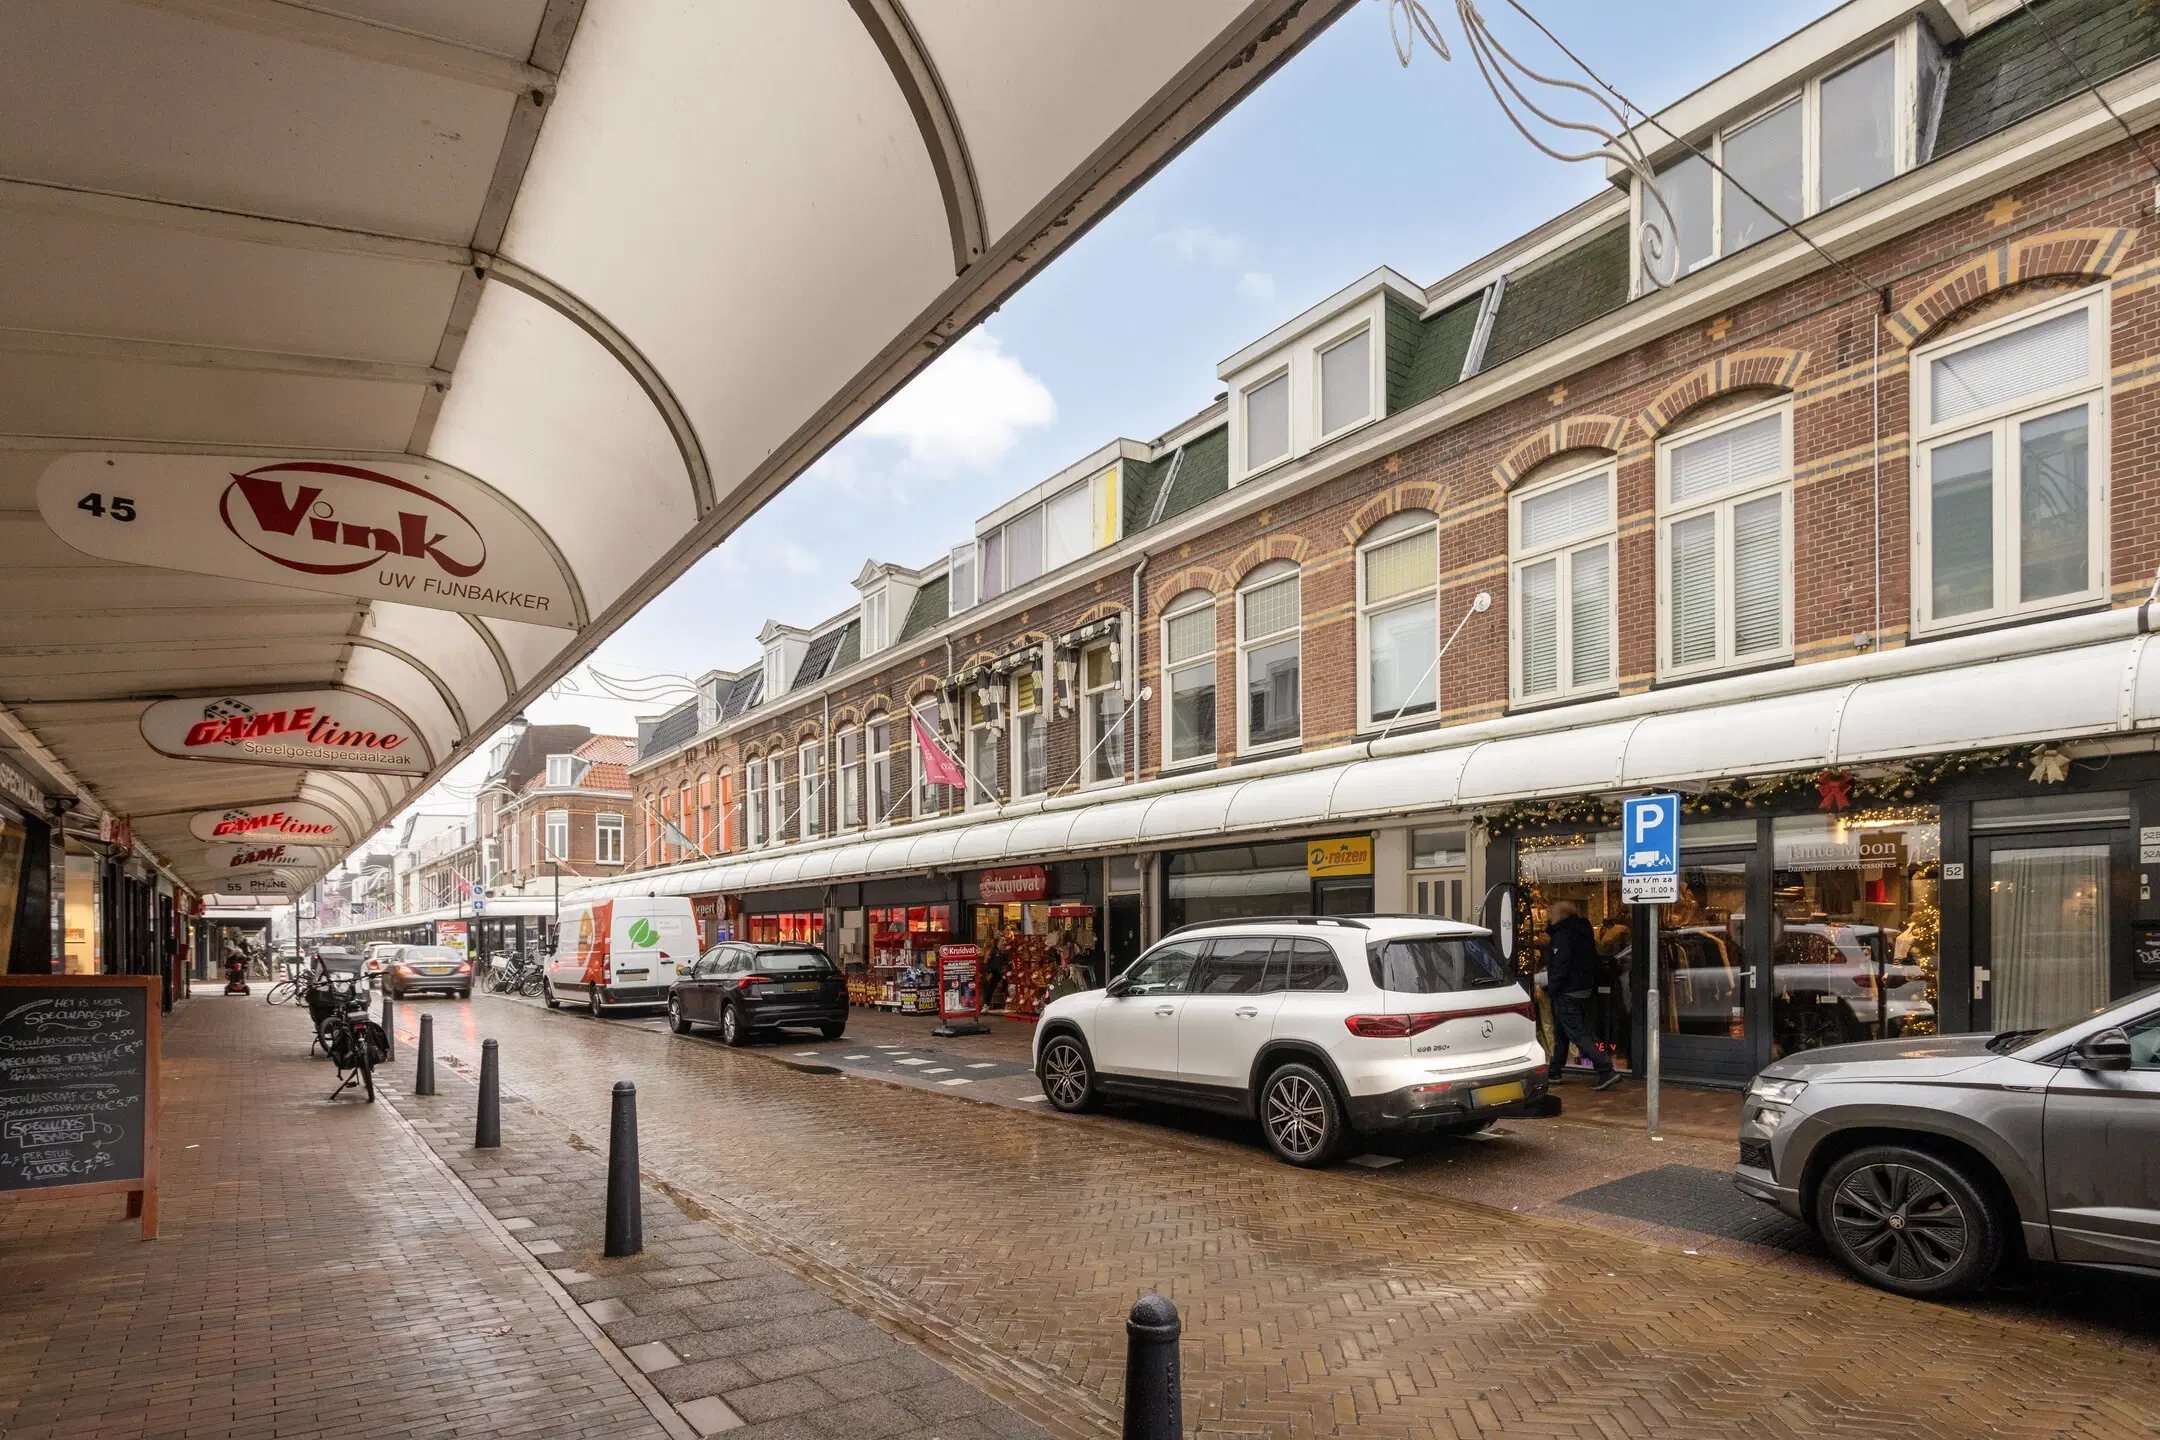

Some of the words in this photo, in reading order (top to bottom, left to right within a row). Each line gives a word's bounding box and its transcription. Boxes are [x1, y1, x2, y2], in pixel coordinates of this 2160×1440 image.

[77, 492, 137, 522] 45
[229, 472, 468, 574] Vink
[378, 570, 416, 591] UW
[423, 578, 551, 612] FIJNBAKKER
[244, 740, 412, 765] Speelgoedspeciaalzaak
[1636, 803, 1664, 843] P
[1787, 843, 1836, 859] Tante
[1840, 841, 1897, 857] Moon
[1787, 864, 1836, 873] Damesmode
[1847, 861, 1897, 870] Accessoires
[1945, 866, 1962, 877] 52
[227, 883, 242, 891] 55
[994, 875, 1040, 894] Kruidvat
[1622, 887, 1643, 895] 06.00
[949, 947, 975, 955] Kruidvat
[36, 1162, 70, 1175] VOOR
